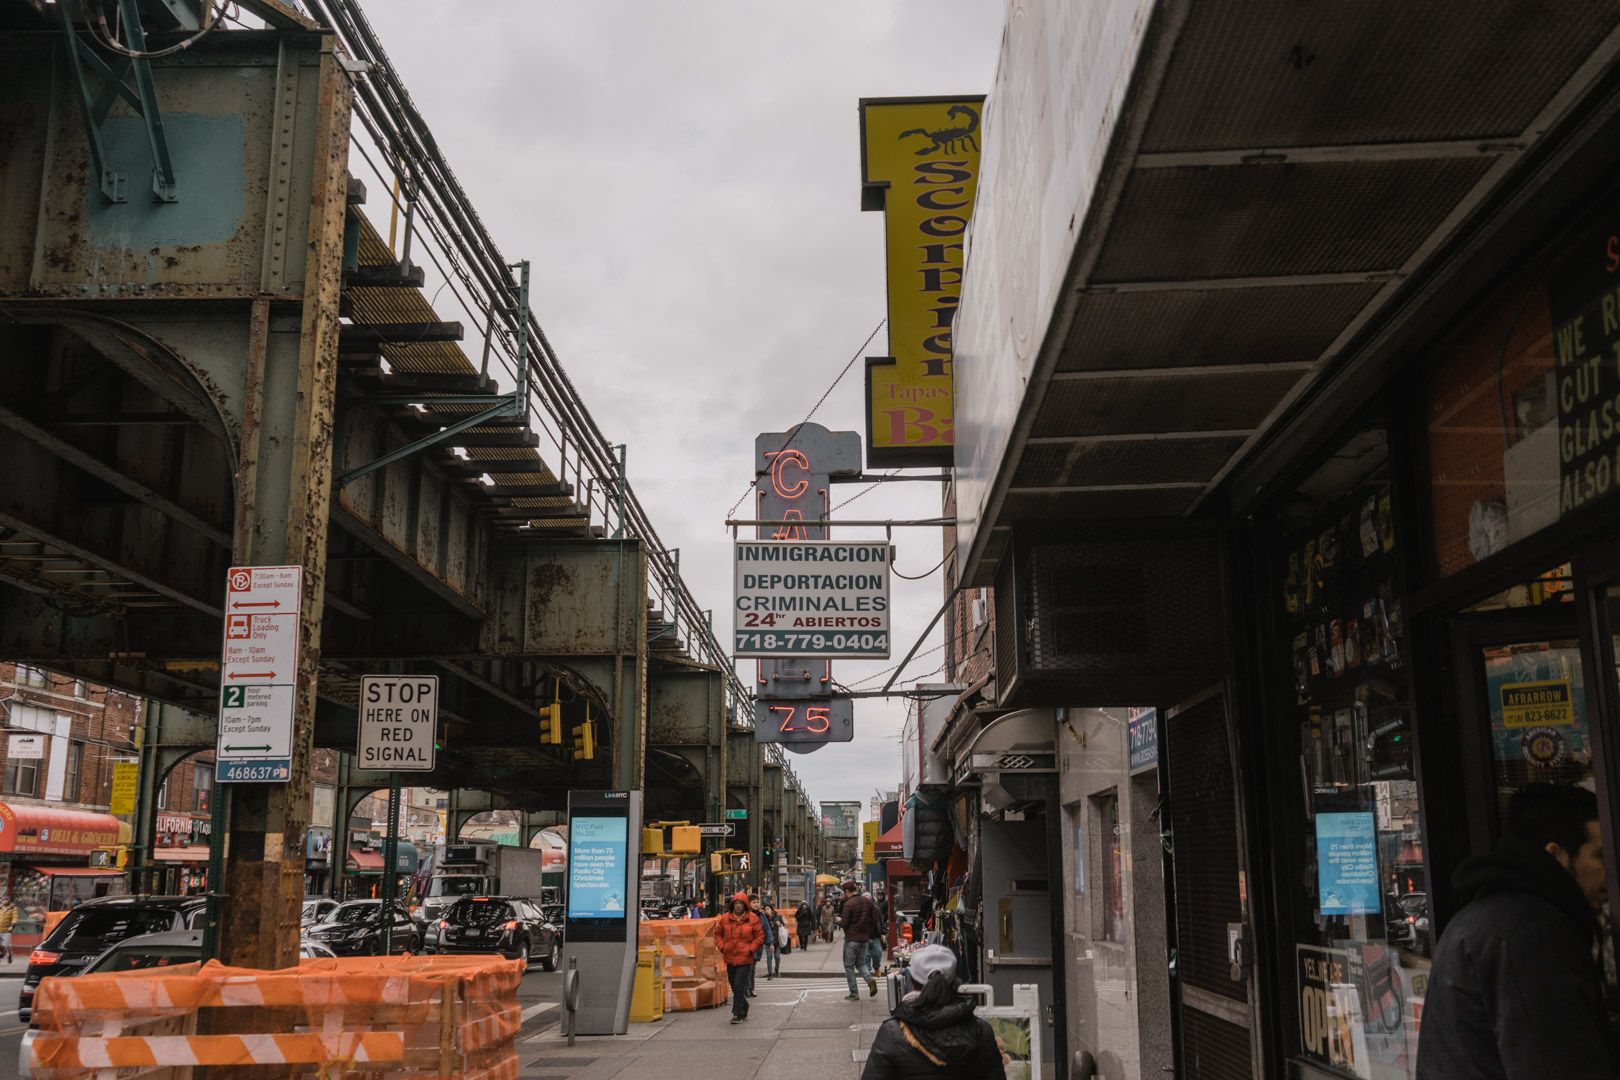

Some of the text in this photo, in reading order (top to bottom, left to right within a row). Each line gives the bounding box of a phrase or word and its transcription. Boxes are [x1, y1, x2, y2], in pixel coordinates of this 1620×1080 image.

[1607, 235, 1620, 271] S
[1559, 315, 1586, 367] WE
[1560, 355, 1601, 413] CUT
[883, 383, 949, 402] Tapas
[881, 406, 954, 445] Ba
[1559, 455, 1610, 516] ALSO
[764, 449, 810, 540] CA
[738, 546, 886, 562] INMIGRACION
[254, 582, 294, 590] Except Sunday
[743, 574, 882, 590] DEPORTACION
[736, 595, 887, 612] CRIMINALES
[253, 624, 279, 632] Loading
[792, 616, 882, 628] ABIERTOS
[252, 632, 268, 640] Only
[736, 634, 888, 650] 718-779-0404
[228, 655, 276, 664] Except Sunday
[227, 686, 240, 706] 2
[367, 682, 432, 704] STOP
[248, 716, 262, 724] 7pm
[366, 708, 430, 723] HERE ON
[1524, 710, 1568, 722] 823-6622
[248, 725, 272, 733] Sunday
[381, 728, 413, 742] RED
[366, 746, 427, 762] SIGNAL
[227, 766, 272, 780] 468637
[50, 829, 70, 842] DELI
[81, 832, 119, 846] GROCERY
[1302, 985, 1355, 1067] OPEN
